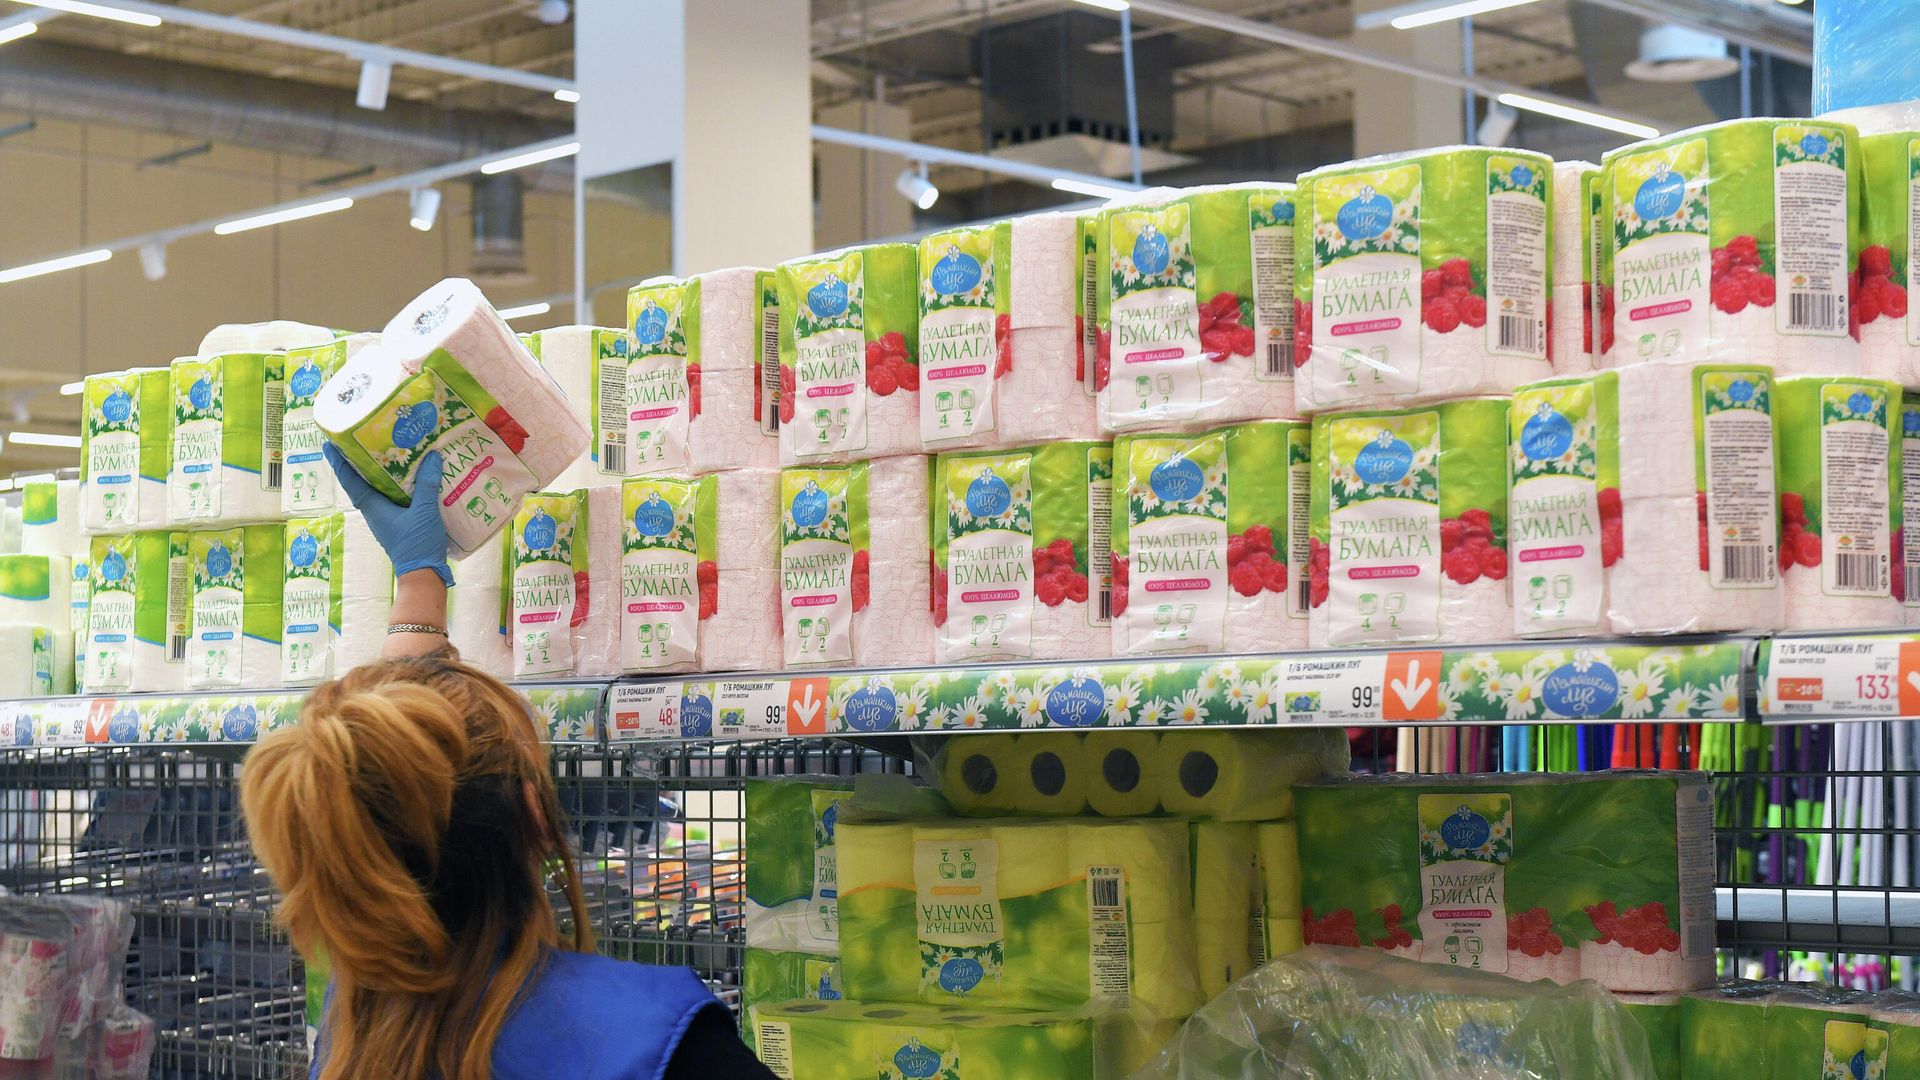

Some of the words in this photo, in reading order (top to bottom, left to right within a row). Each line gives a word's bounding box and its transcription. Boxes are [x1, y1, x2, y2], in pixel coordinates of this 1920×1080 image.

[1621, 248, 1700, 276] ТУАЛЕТНАЯ
[1323, 268, 1411, 292] ТУАЛЕТНАЯ
[1621, 268, 1702, 302] БУМАГА
[1322, 288, 1412, 318] БУМАГА
[1119, 320, 1196, 346] БУМАГА
[801, 357, 861, 382] БУМАГА
[1346, 372, 1355, 384] 4
[1369, 367, 1380, 380] 2
[1139, 399, 1147, 409] 4
[940, 414, 947, 424] 4
[964, 411, 971, 422] 2
[818, 430, 827, 440] 4
[655, 447, 662, 457] 2
[93, 455, 136, 471] БУМАГА
[295, 490, 300, 499] 4
[310, 488, 316, 498] 2
[106, 509, 113, 519] 4
[484, 513, 494, 524] 4
[499, 494, 509, 505] 2
[1340, 516, 1429, 534] ТУАЛЕТНАЯ
[1513, 512, 1594, 543] БУМАГА
[1137, 531, 1218, 549] ТУАЛЕТНАЯ
[1339, 534, 1433, 560] БУМАГА
[784, 552, 847, 570] ТУАЛЕТНАЯ
[955, 545, 1024, 562] ТУАЛЕТНАЯ
[1137, 550, 1220, 573] БУМАГА
[623, 562, 689, 577] ТУАЛЕТНАЯ
[954, 561, 1029, 585] БУМАГА
[623, 577, 692, 597] БУМАГА
[784, 568, 846, 591] БУМАГА
[515, 588, 571, 609] БУМАГА
[1557, 601, 1565, 614] 2
[92, 614, 133, 631] БУМАГА
[198, 610, 239, 627] БУМАГА
[1361, 616, 1371, 629] 4
[1390, 615, 1399, 627] 2
[641, 644, 649, 654] 4
[661, 643, 667, 654] 2
[820, 638, 826, 649] 2
[970, 637, 978, 647] 4
[992, 635, 998, 646] 2
[1780, 644, 1797, 654] Т/Б
[1800, 643, 1853, 654] РОМАШКИН
[1855, 643, 1873, 653] ЛУГ
[525, 652, 531, 661] 4
[542, 650, 549, 660] 2
[291, 661, 296, 669] 4
[1289, 664, 1301, 672] Т/Б
[1303, 661, 1345, 671] РОМАШКИН
[1346, 660, 1361, 669] ЛУГ
[627, 687, 655, 696] РОМАШКИН
[723, 683, 732, 691] Т/Б
[733, 683, 763, 691] РОМАШКИН
[764, 682, 774, 690] ЛУГ
[1546, 673, 1615, 695] Ромашкин
[1856, 675, 1890, 700] 133
[848, 692, 894, 714] Ромашкин
[1050, 686, 1102, 707] Ромашкин
[1352, 686, 1372, 708] 99
[659, 708, 673, 726] 48
[766, 705, 780, 724] 99
[1, 721, 10, 737] 48
[73, 720, 83, 734] 99
[942, 851, 949, 862] 2
[963, 851, 971, 862] 8
[1429, 872, 1496, 887] ТУАЛЕТНАЯ
[1430, 885, 1498, 906] БУМАГА
[922, 904, 994, 920] БУМАГА
[925, 922, 997, 934] ТУАЛЕТНАЯ
[1450, 954, 1457, 964] 8
[1472, 954, 1479, 965] 2
